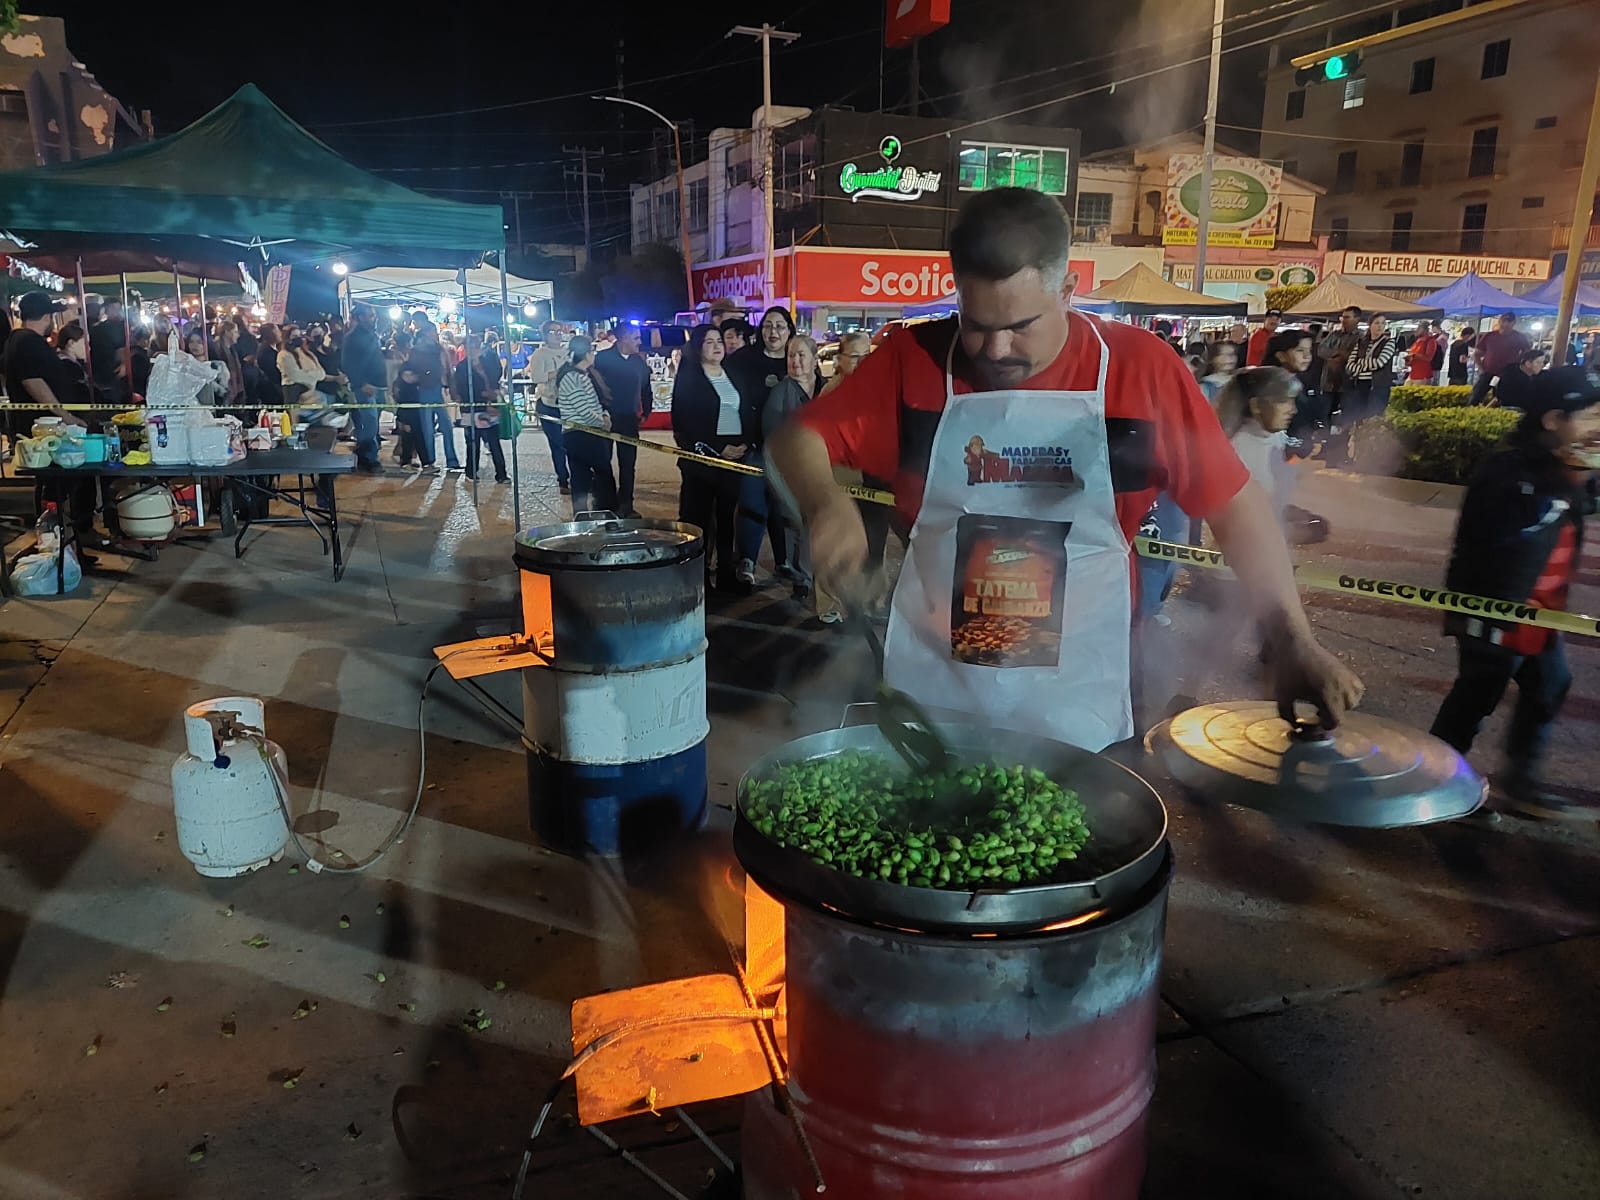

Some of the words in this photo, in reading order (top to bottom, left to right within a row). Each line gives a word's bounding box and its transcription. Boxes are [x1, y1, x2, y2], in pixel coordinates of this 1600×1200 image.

[899, 166, 942, 193] Digital
[1355, 256, 1419, 272] PAPELERA
[1426, 258, 1443, 273] DE
[1214, 269, 1252, 280] CREATIVO
